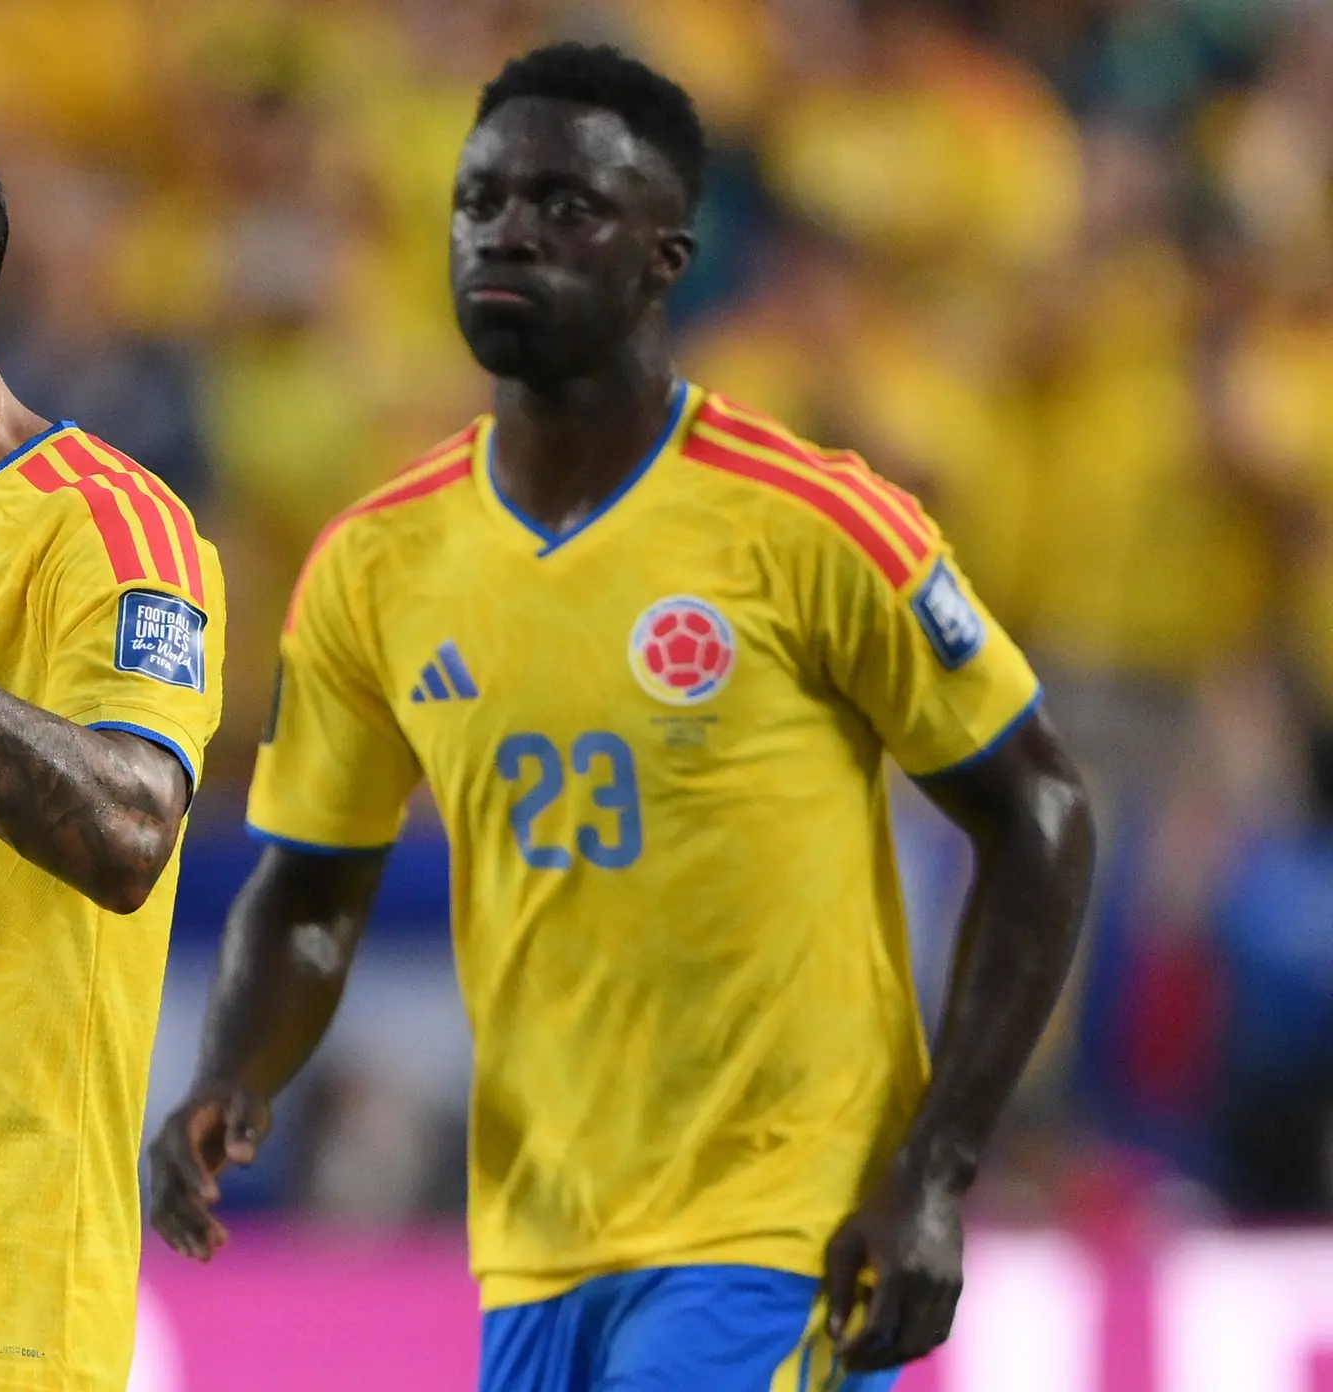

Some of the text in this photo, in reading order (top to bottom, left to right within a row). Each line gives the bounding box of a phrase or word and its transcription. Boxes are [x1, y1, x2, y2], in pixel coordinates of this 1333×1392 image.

[137, 604, 190, 635] FOOTBALL
[135, 619, 190, 652] UNITES
[130, 638, 191, 668] the World
[149, 654, 173, 672] FIFA
[496, 730, 643, 870] 23
